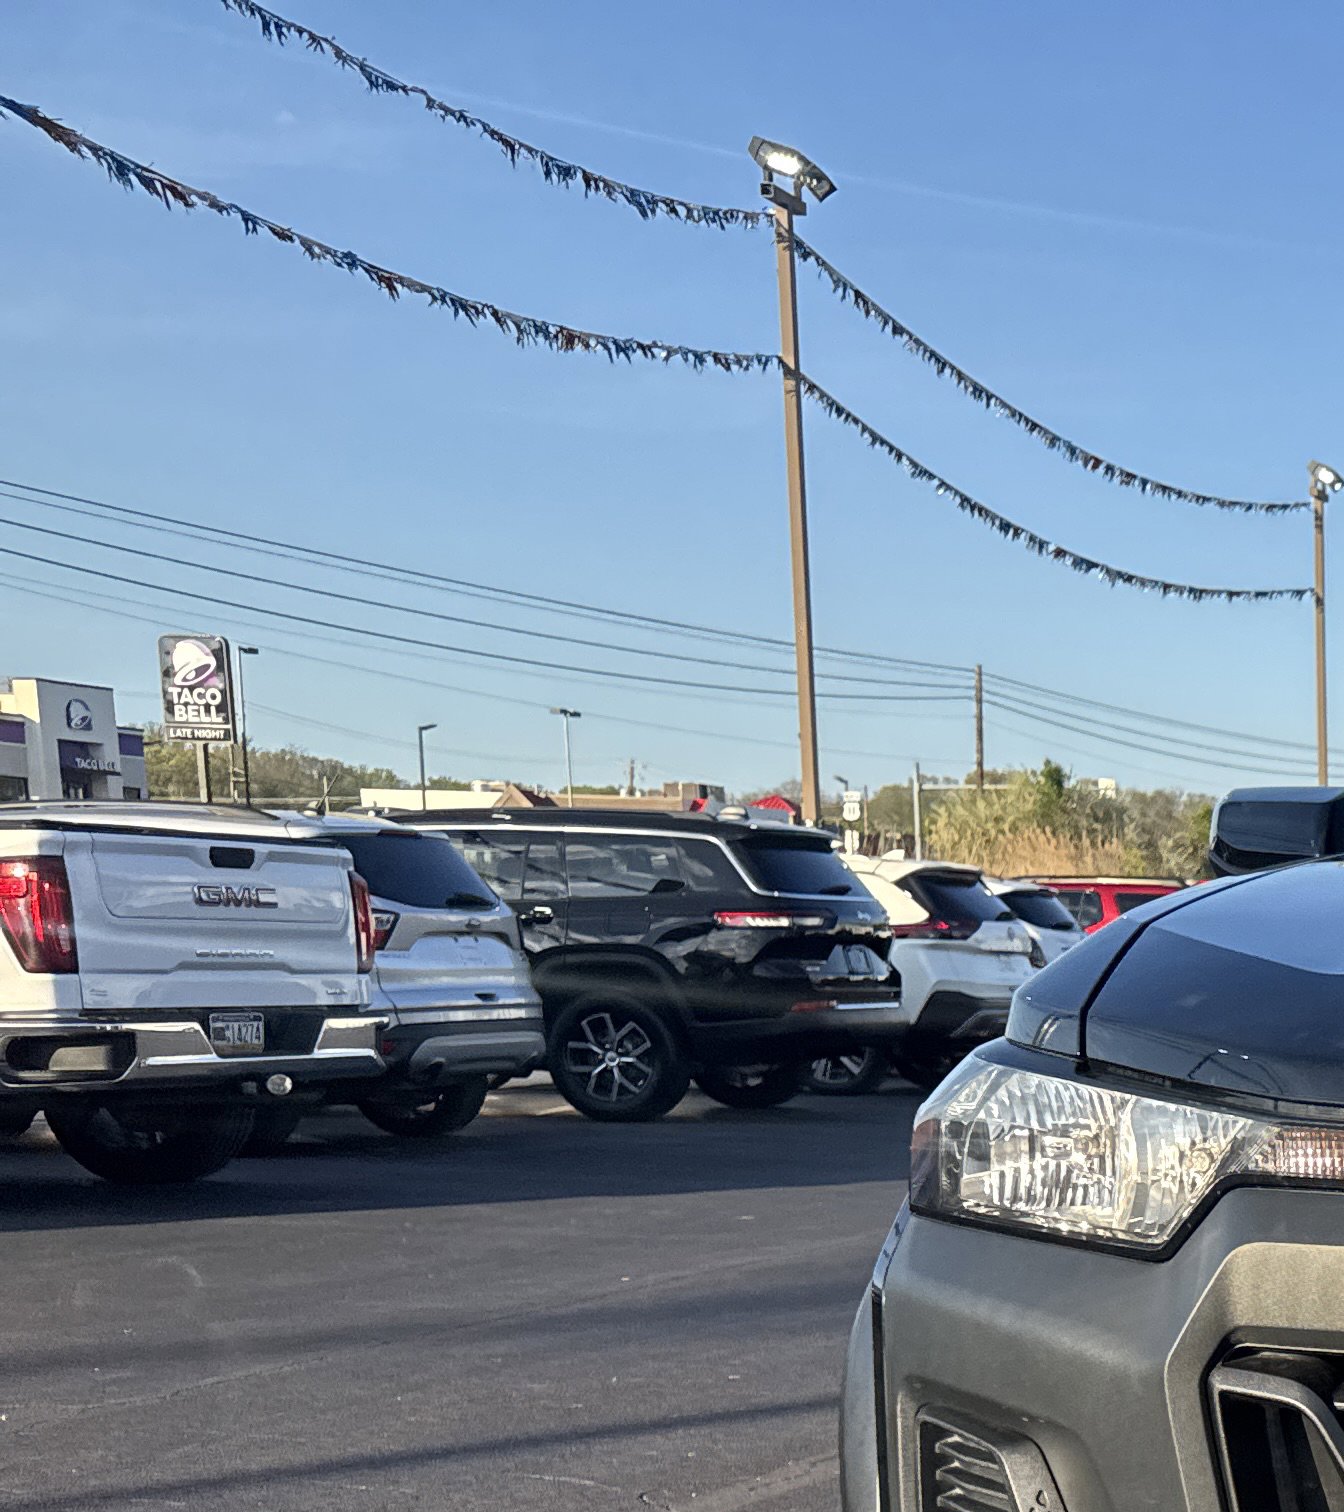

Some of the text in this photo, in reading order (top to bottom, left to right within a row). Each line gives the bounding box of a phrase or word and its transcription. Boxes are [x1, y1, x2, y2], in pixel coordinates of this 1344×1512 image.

[168, 687, 222, 705] TACO
[174, 705, 223, 722] BELL
[169, 728, 225, 739] LATE NIGHT
[75, 757, 97, 769] TACO
[193, 885, 278, 909] GMC
